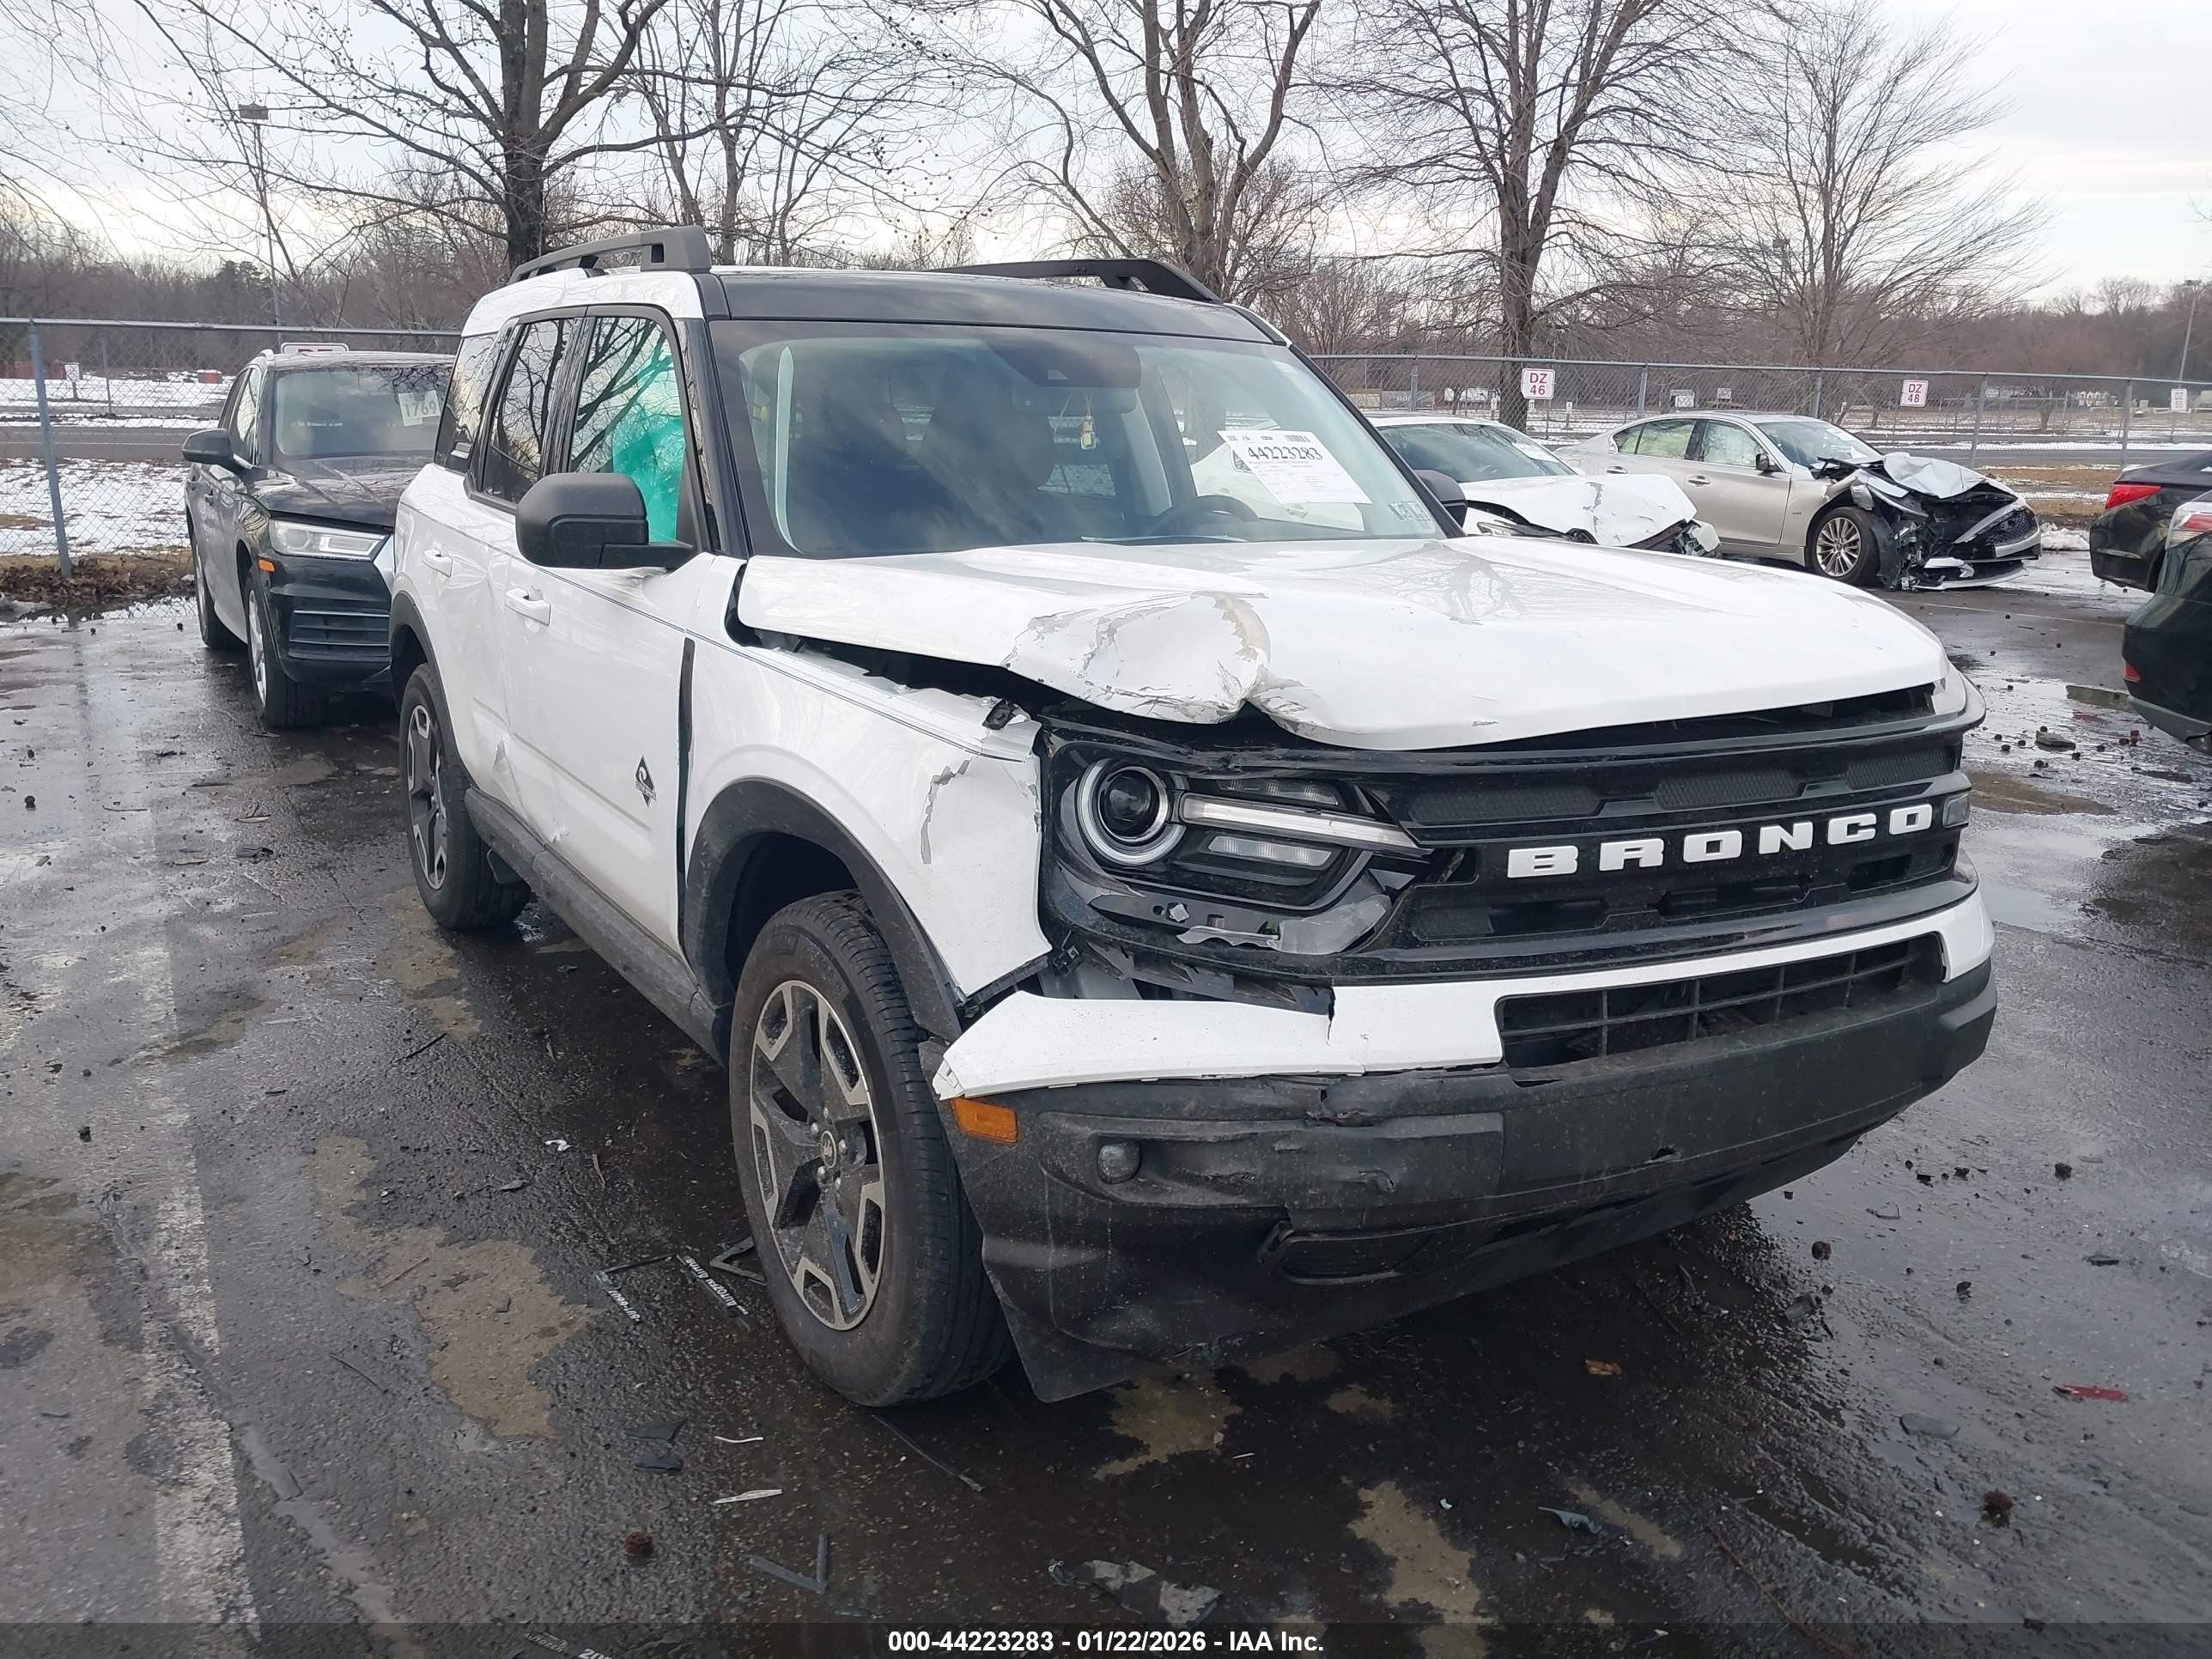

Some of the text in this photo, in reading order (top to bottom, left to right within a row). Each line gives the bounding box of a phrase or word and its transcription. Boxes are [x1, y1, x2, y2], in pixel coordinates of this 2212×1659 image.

[1529, 373, 1548, 384] DZ
[1529, 385, 1547, 396] 46
[1908, 383, 1923, 393] DZ
[1907, 393, 1920, 404] 48
[1248, 447, 1323, 460] 44223283
[1507, 804, 1933, 878] BRONCO
